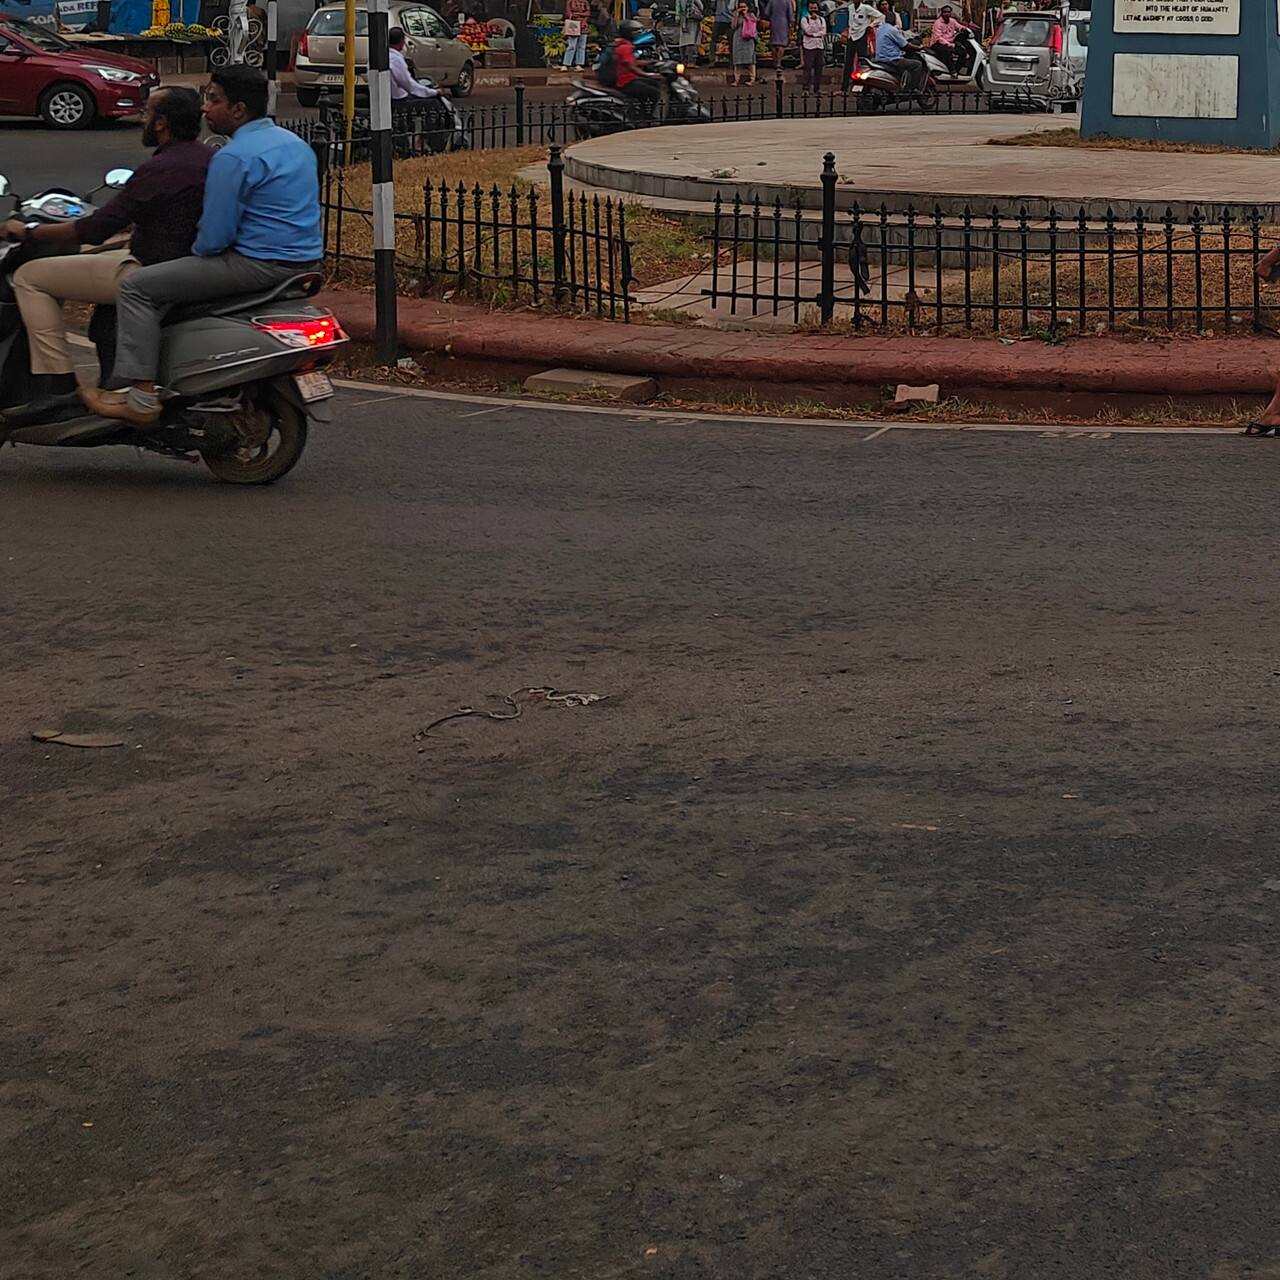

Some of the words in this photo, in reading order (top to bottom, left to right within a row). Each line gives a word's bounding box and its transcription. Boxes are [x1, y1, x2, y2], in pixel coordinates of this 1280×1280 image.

[1145, 5, 1159, 13] INTO
[1160, 5, 1170, 13] THE
[1171, 5, 1190, 13] HEART
[1190, 5, 1199, 13] OF
